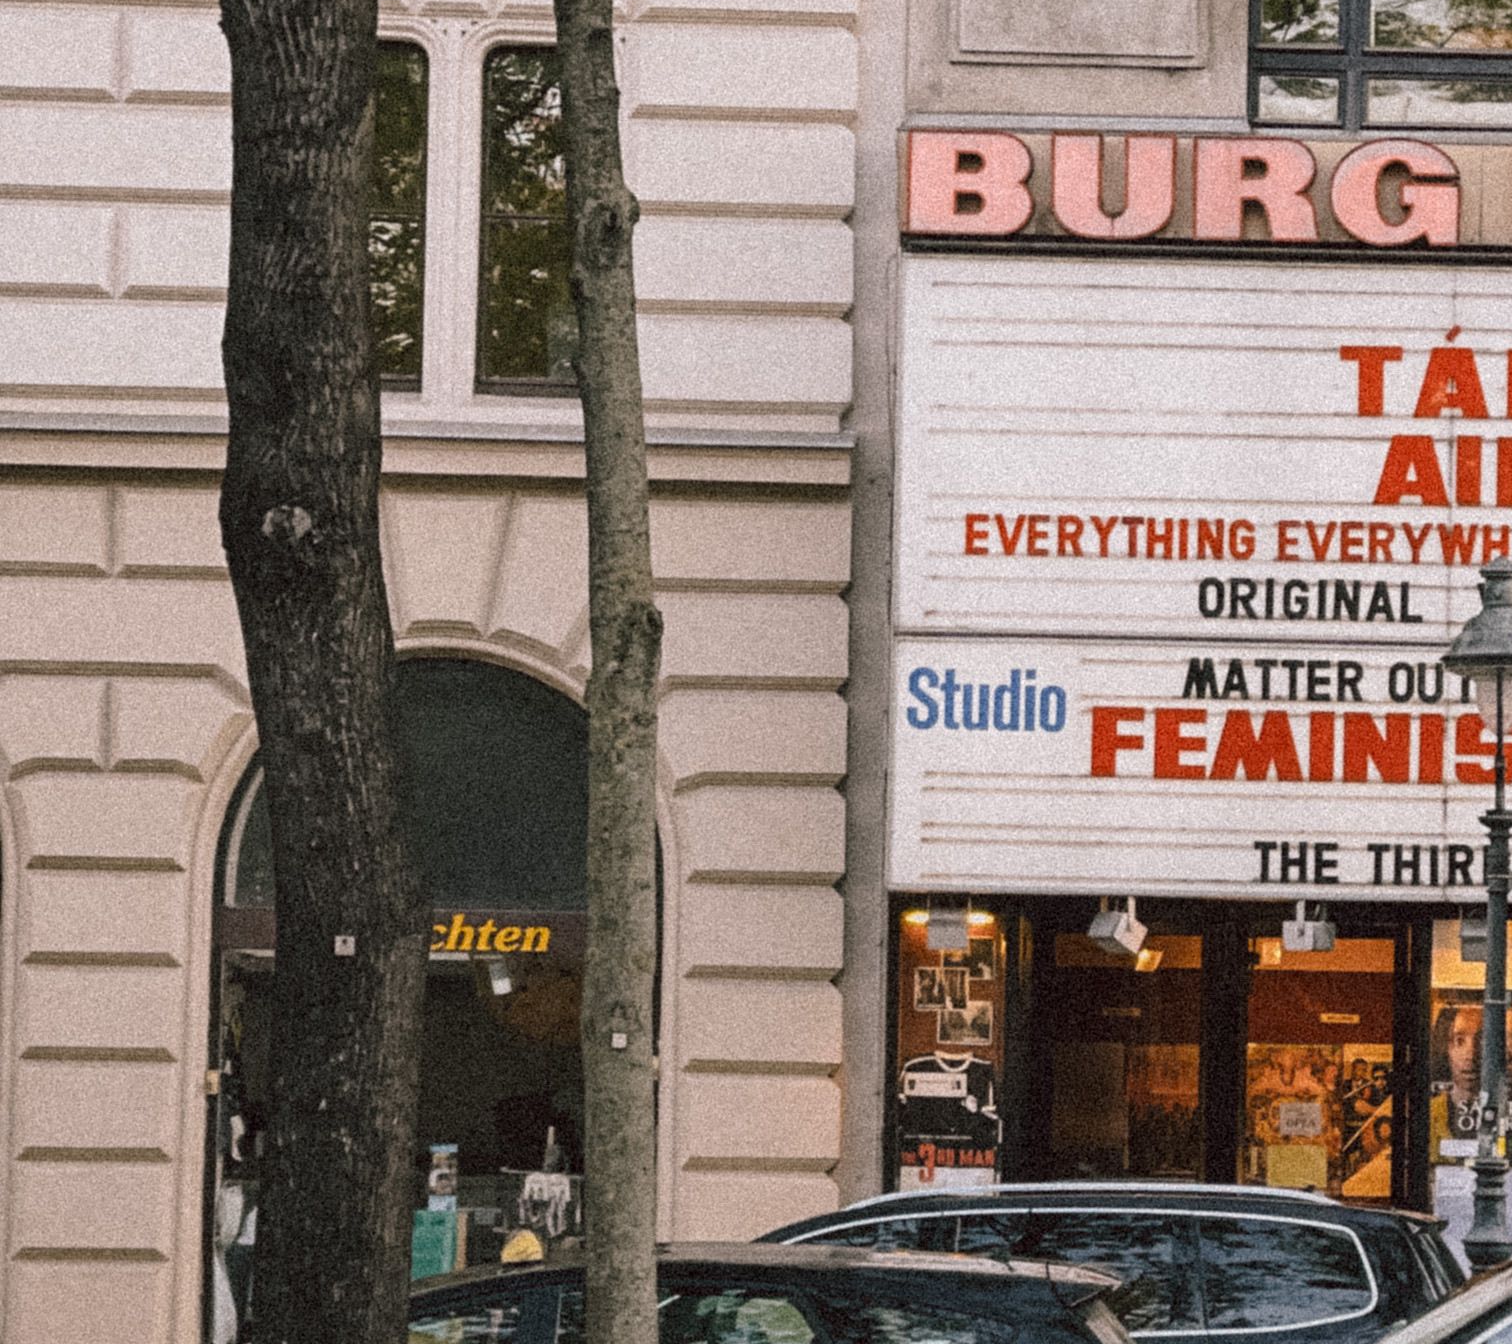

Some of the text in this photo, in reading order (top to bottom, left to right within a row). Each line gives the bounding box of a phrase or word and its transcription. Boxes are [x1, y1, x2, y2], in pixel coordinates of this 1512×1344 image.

[906, 129, 1461, 247] BURG
[964, 513, 1256, 560] EVERYTHING
[1199, 578, 1423, 623] ORIGINAL
[907, 667, 1066, 732] Studio
[1183, 658, 1363, 701] MATTER
[1254, 842, 1339, 885] THE
